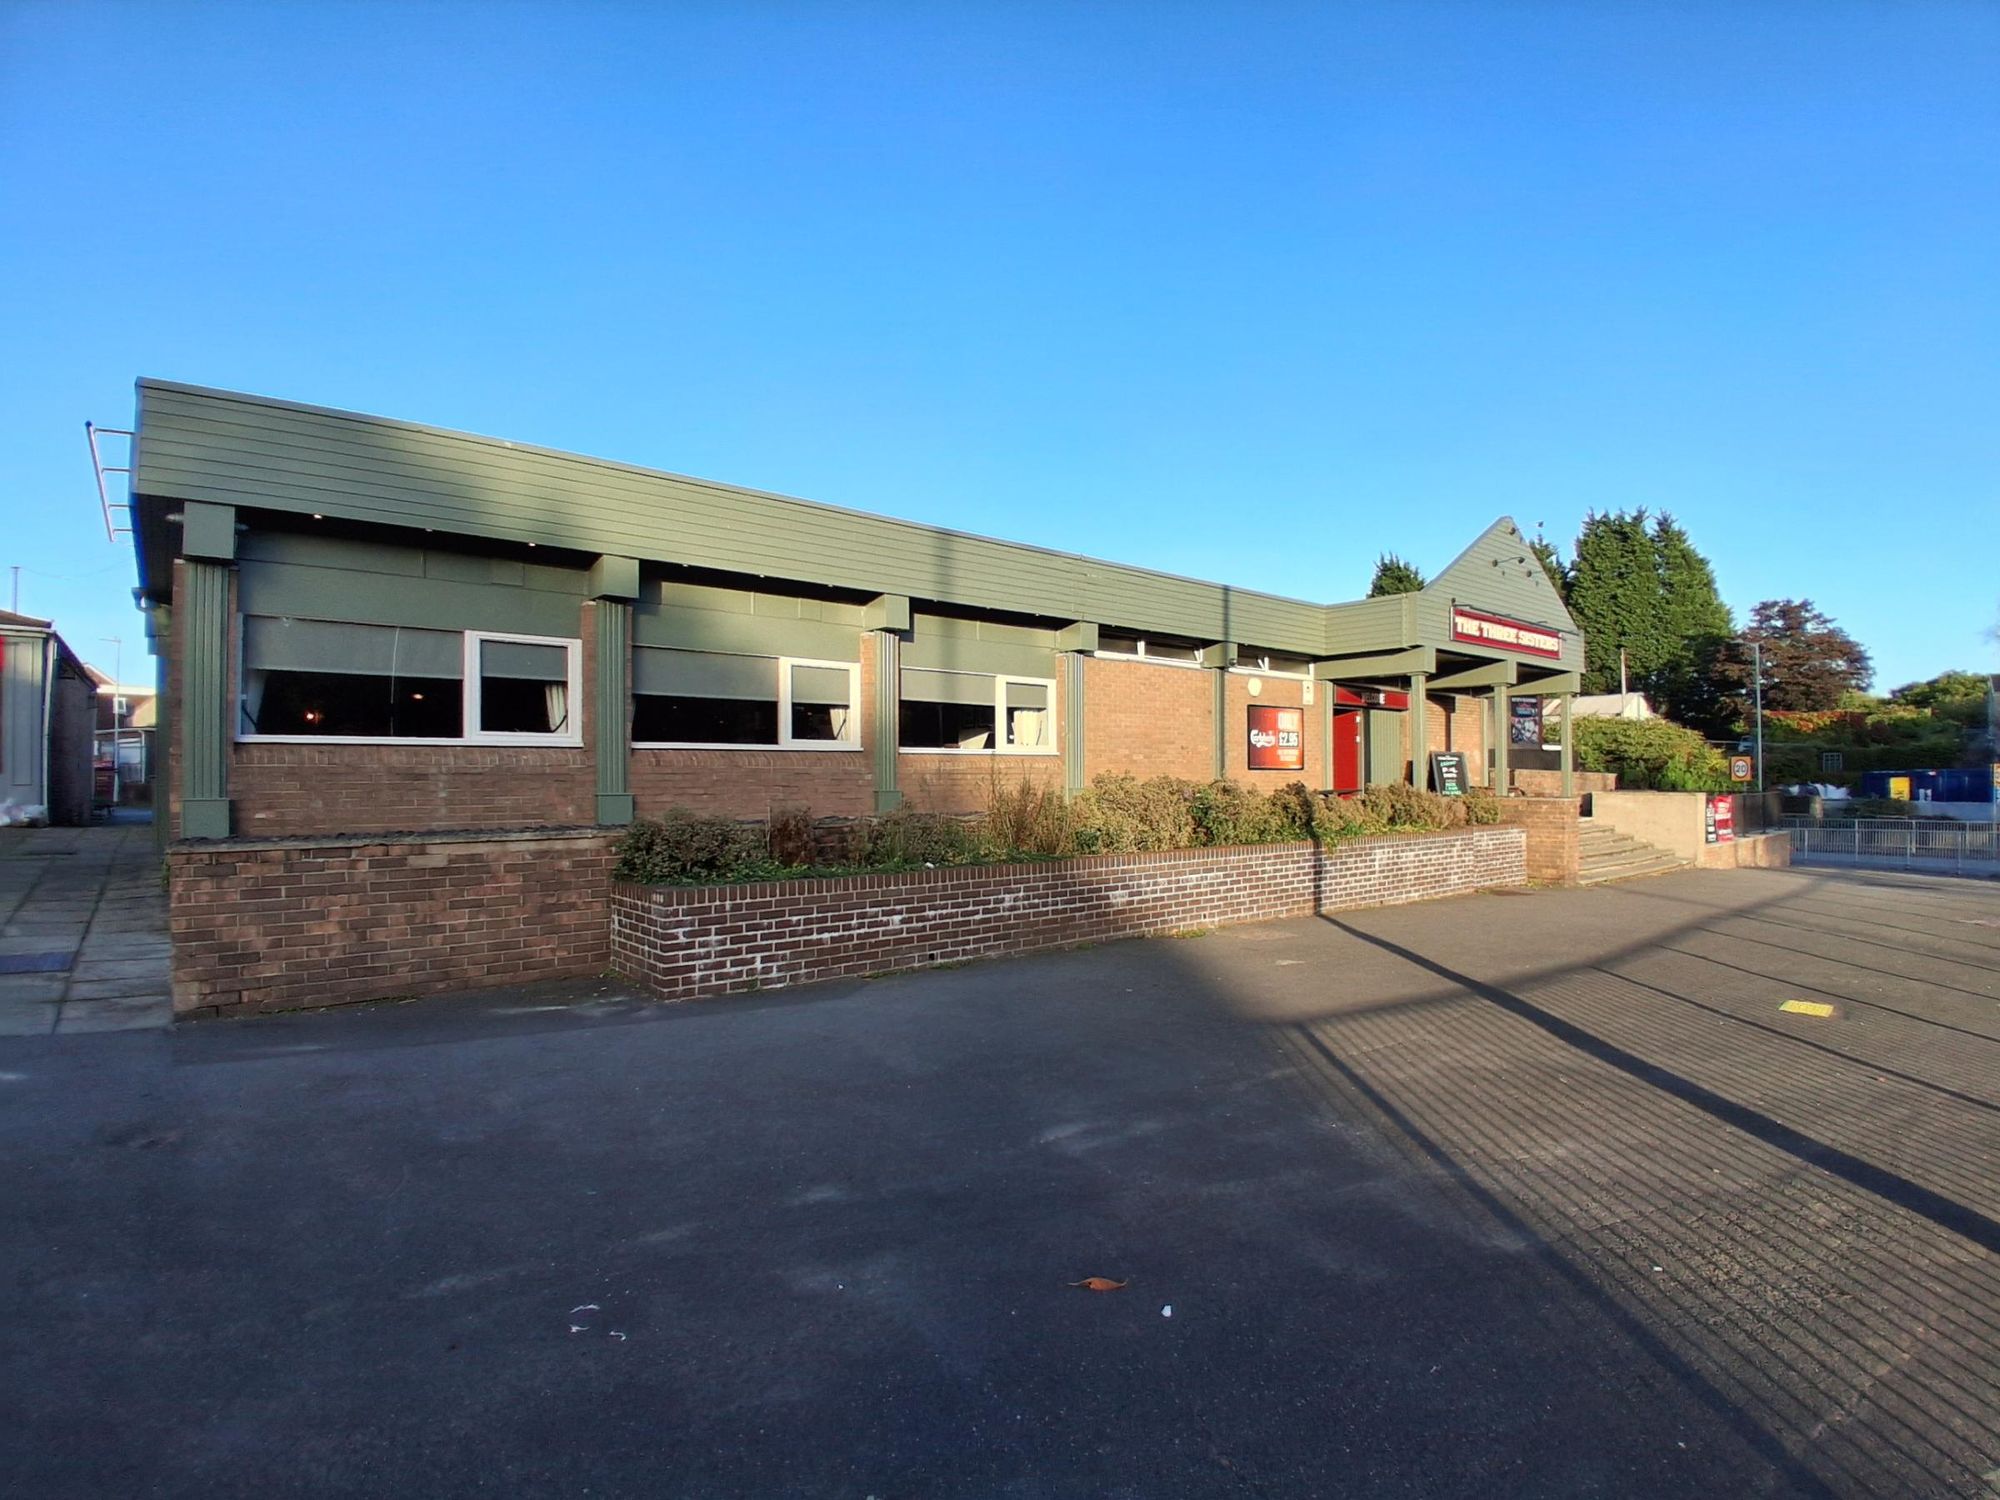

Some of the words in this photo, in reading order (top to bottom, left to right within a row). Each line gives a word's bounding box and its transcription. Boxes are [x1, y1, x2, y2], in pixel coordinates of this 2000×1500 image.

[1455, 616, 1480, 637] THE
[1481, 621, 1518, 644] THREE
[1735, 764, 1747, 773] 20
